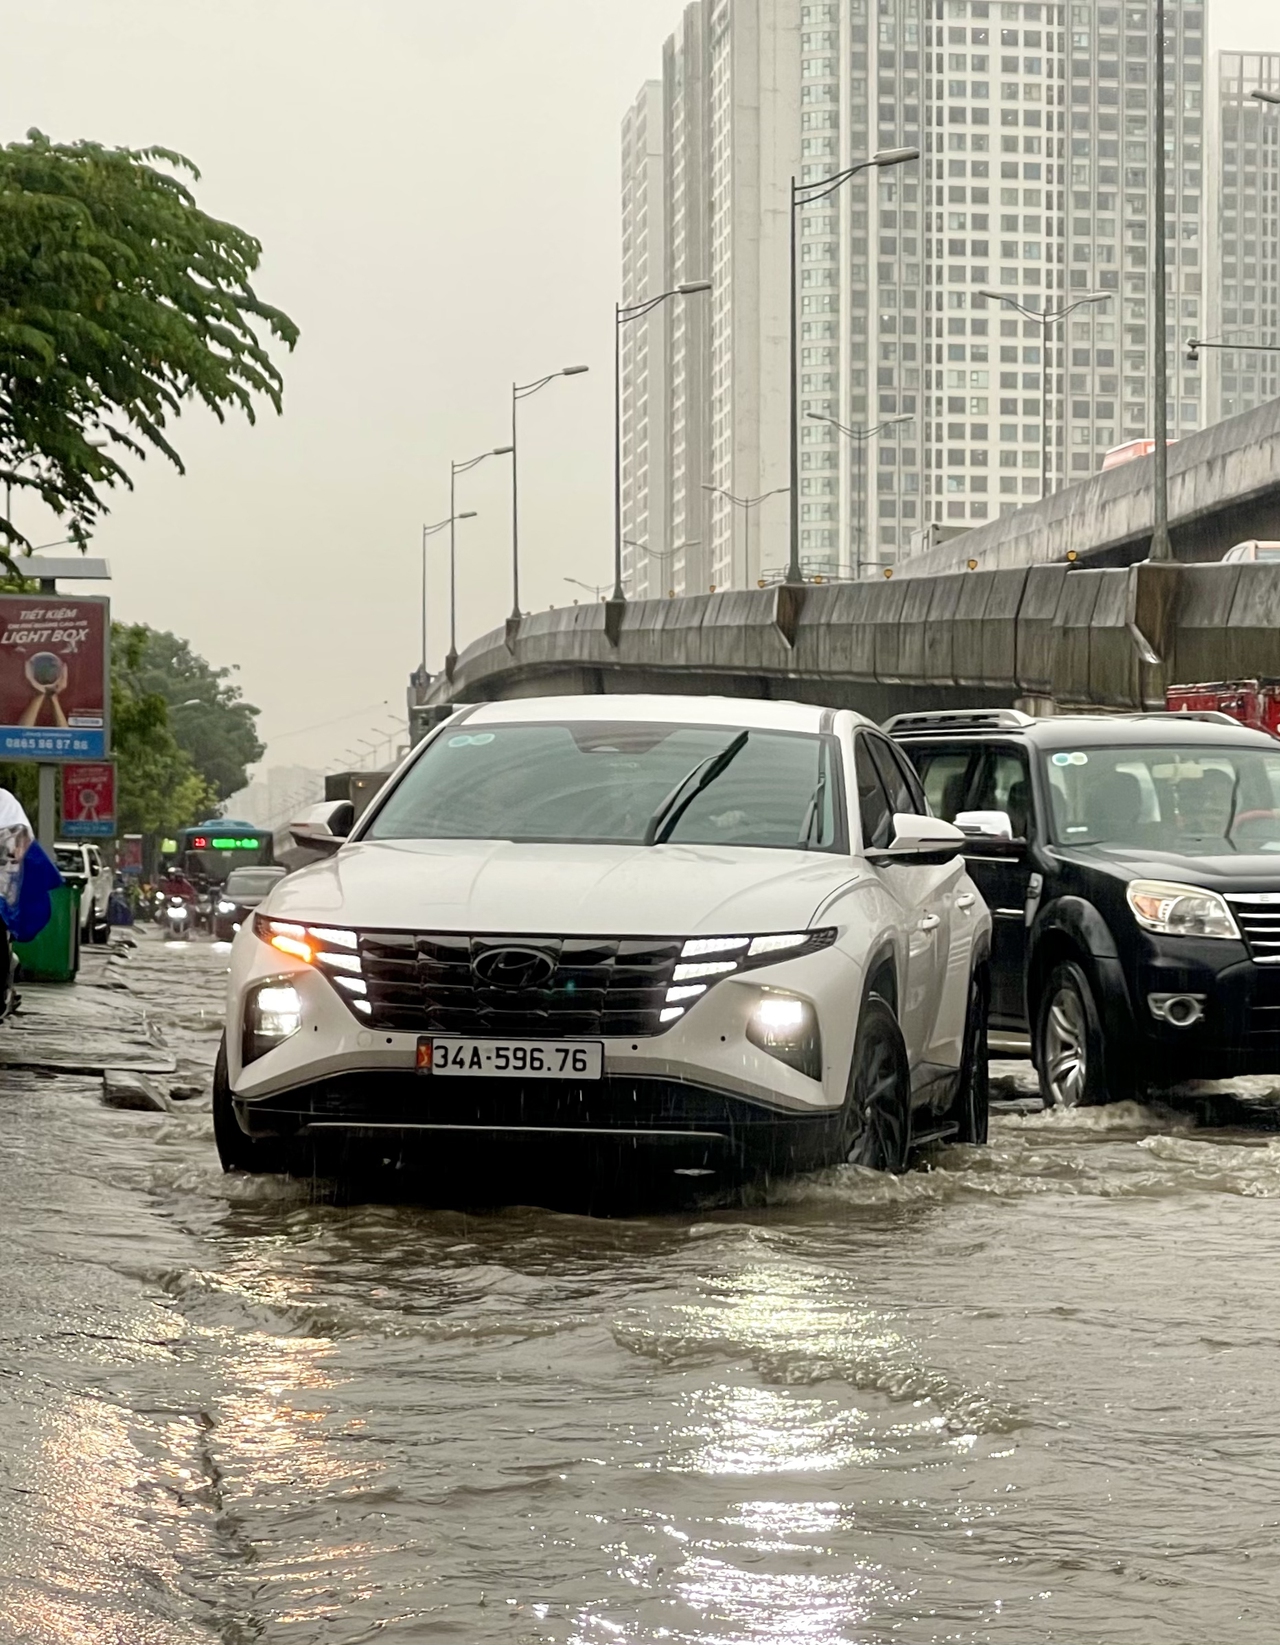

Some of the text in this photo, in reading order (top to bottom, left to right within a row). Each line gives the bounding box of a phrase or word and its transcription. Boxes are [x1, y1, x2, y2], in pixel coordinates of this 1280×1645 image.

[0, 628, 90, 644] LIGHT BOX
[434, 1045, 588, 1072] 34A-596.76
